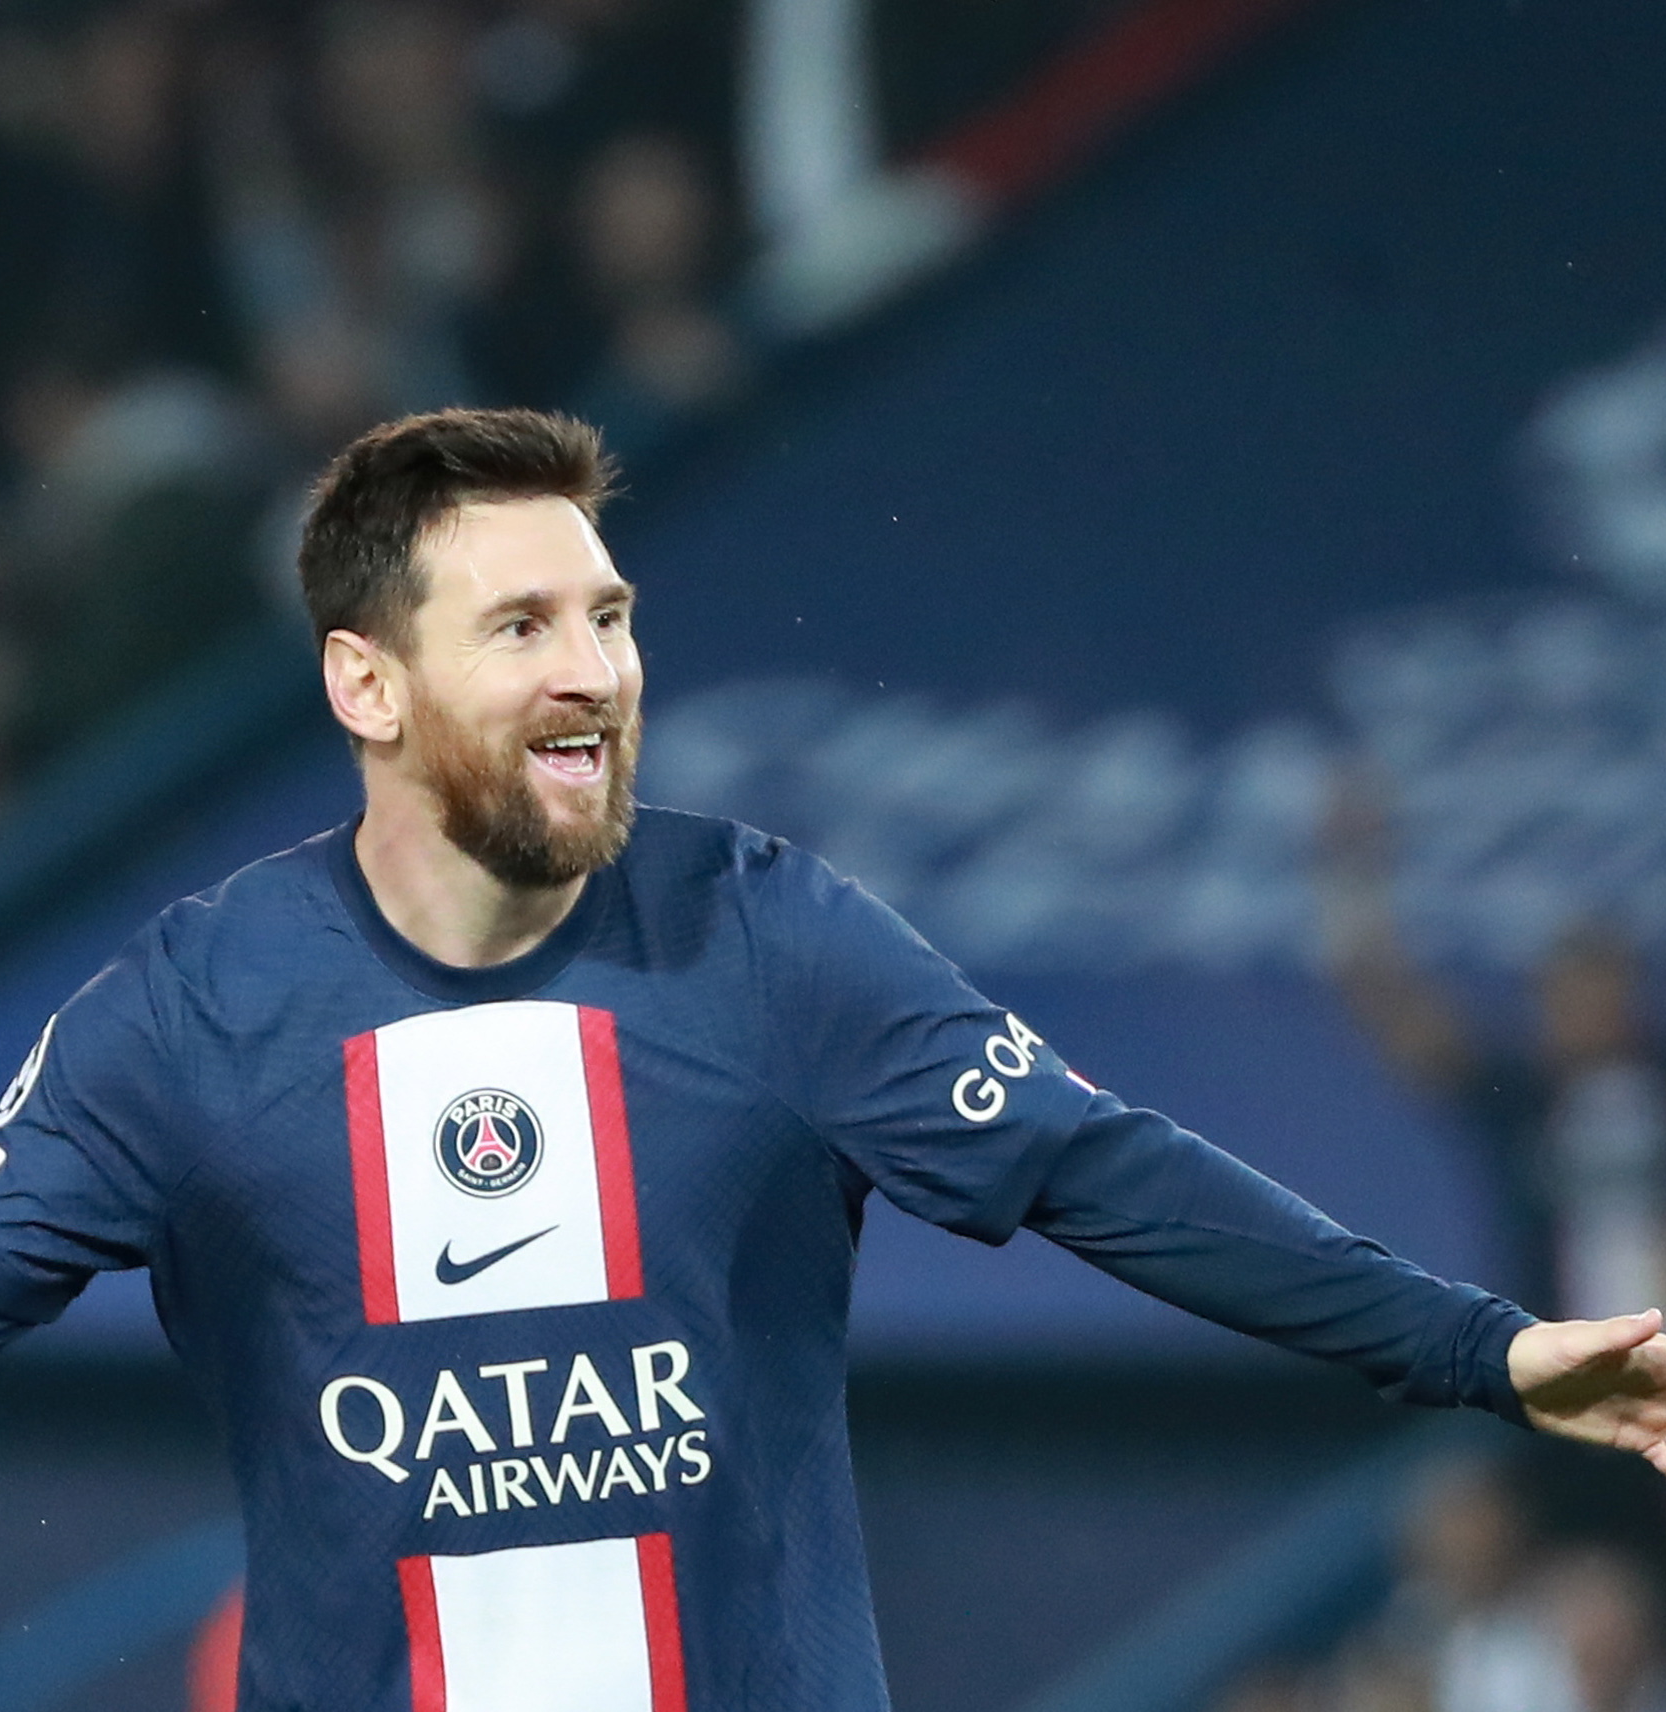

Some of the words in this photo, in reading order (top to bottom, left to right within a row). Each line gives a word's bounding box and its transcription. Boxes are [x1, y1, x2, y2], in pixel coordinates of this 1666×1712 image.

[449, 1094, 520, 1126] PARIS
[318, 1339, 706, 1484] QATAR
[422, 1430, 713, 1520] AIRWAYS
